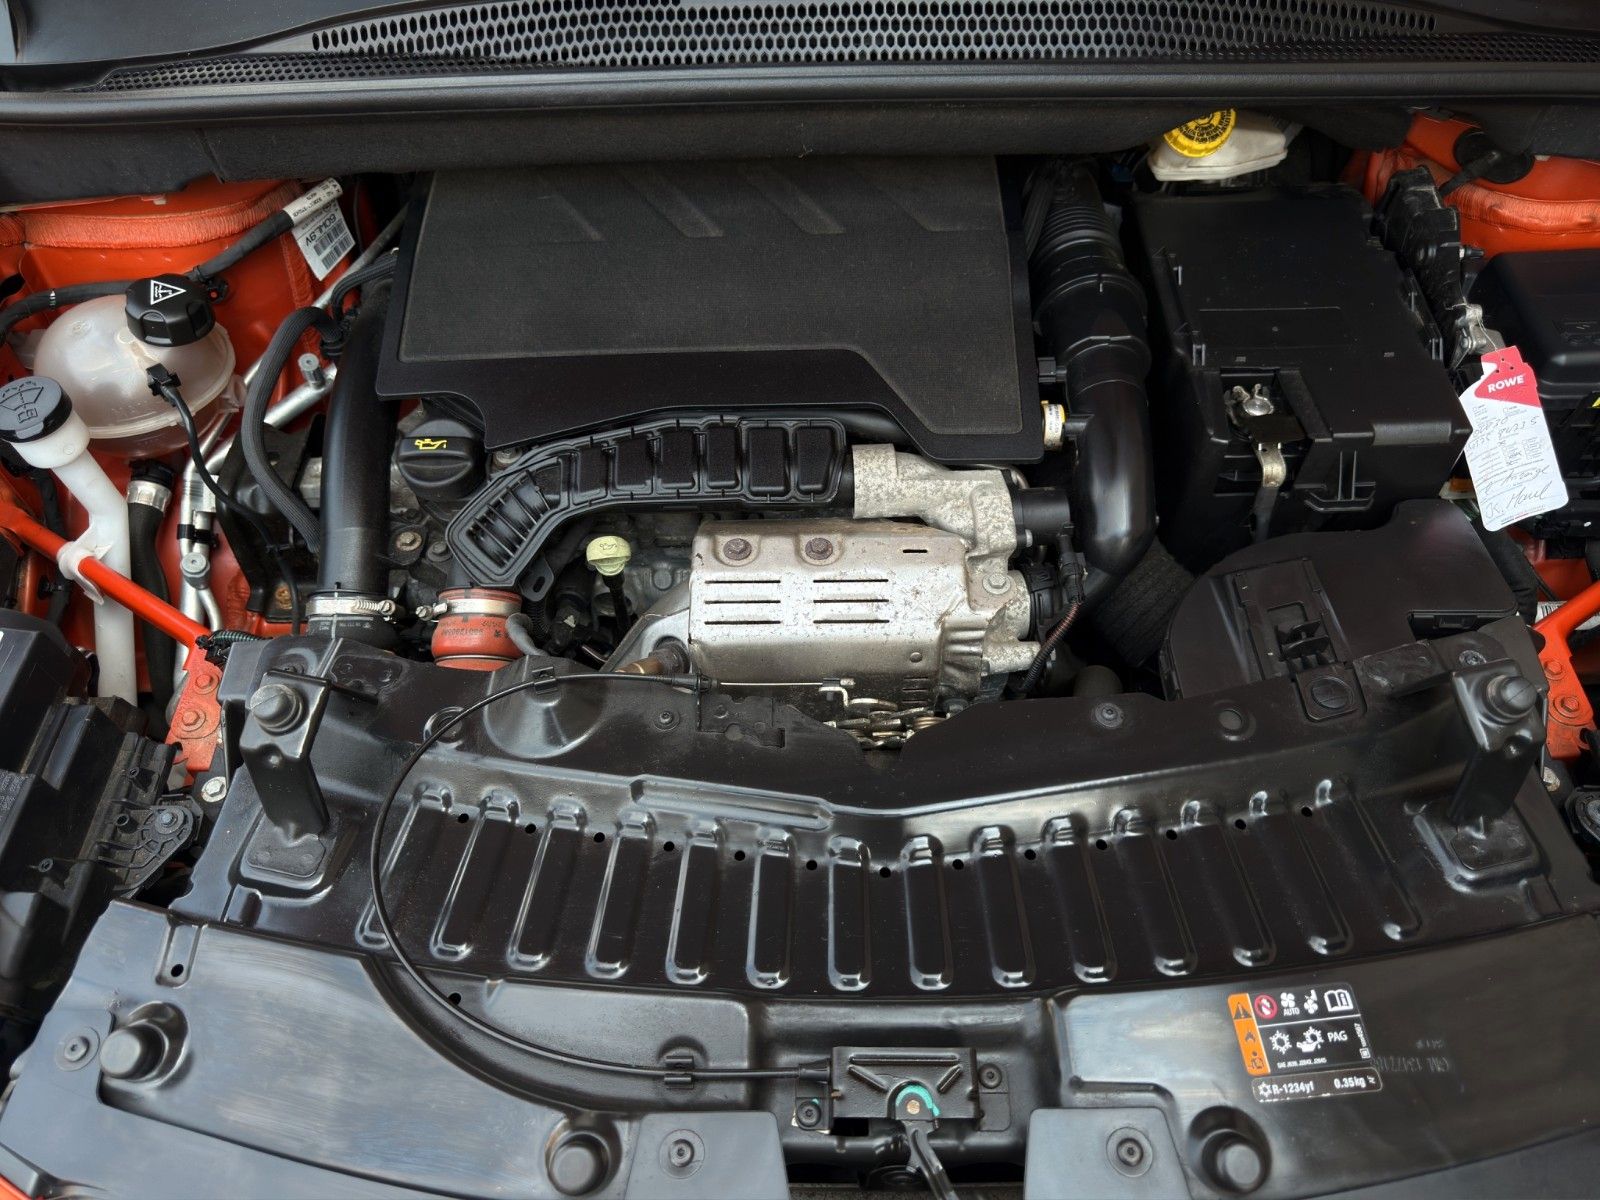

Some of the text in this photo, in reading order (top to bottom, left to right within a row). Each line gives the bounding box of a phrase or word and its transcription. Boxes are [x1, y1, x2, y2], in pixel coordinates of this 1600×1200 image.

[1488, 375, 1524, 394] ROWE
[1283, 1006, 1300, 1016] AUTO
[1327, 1031, 1348, 1042] PAG
